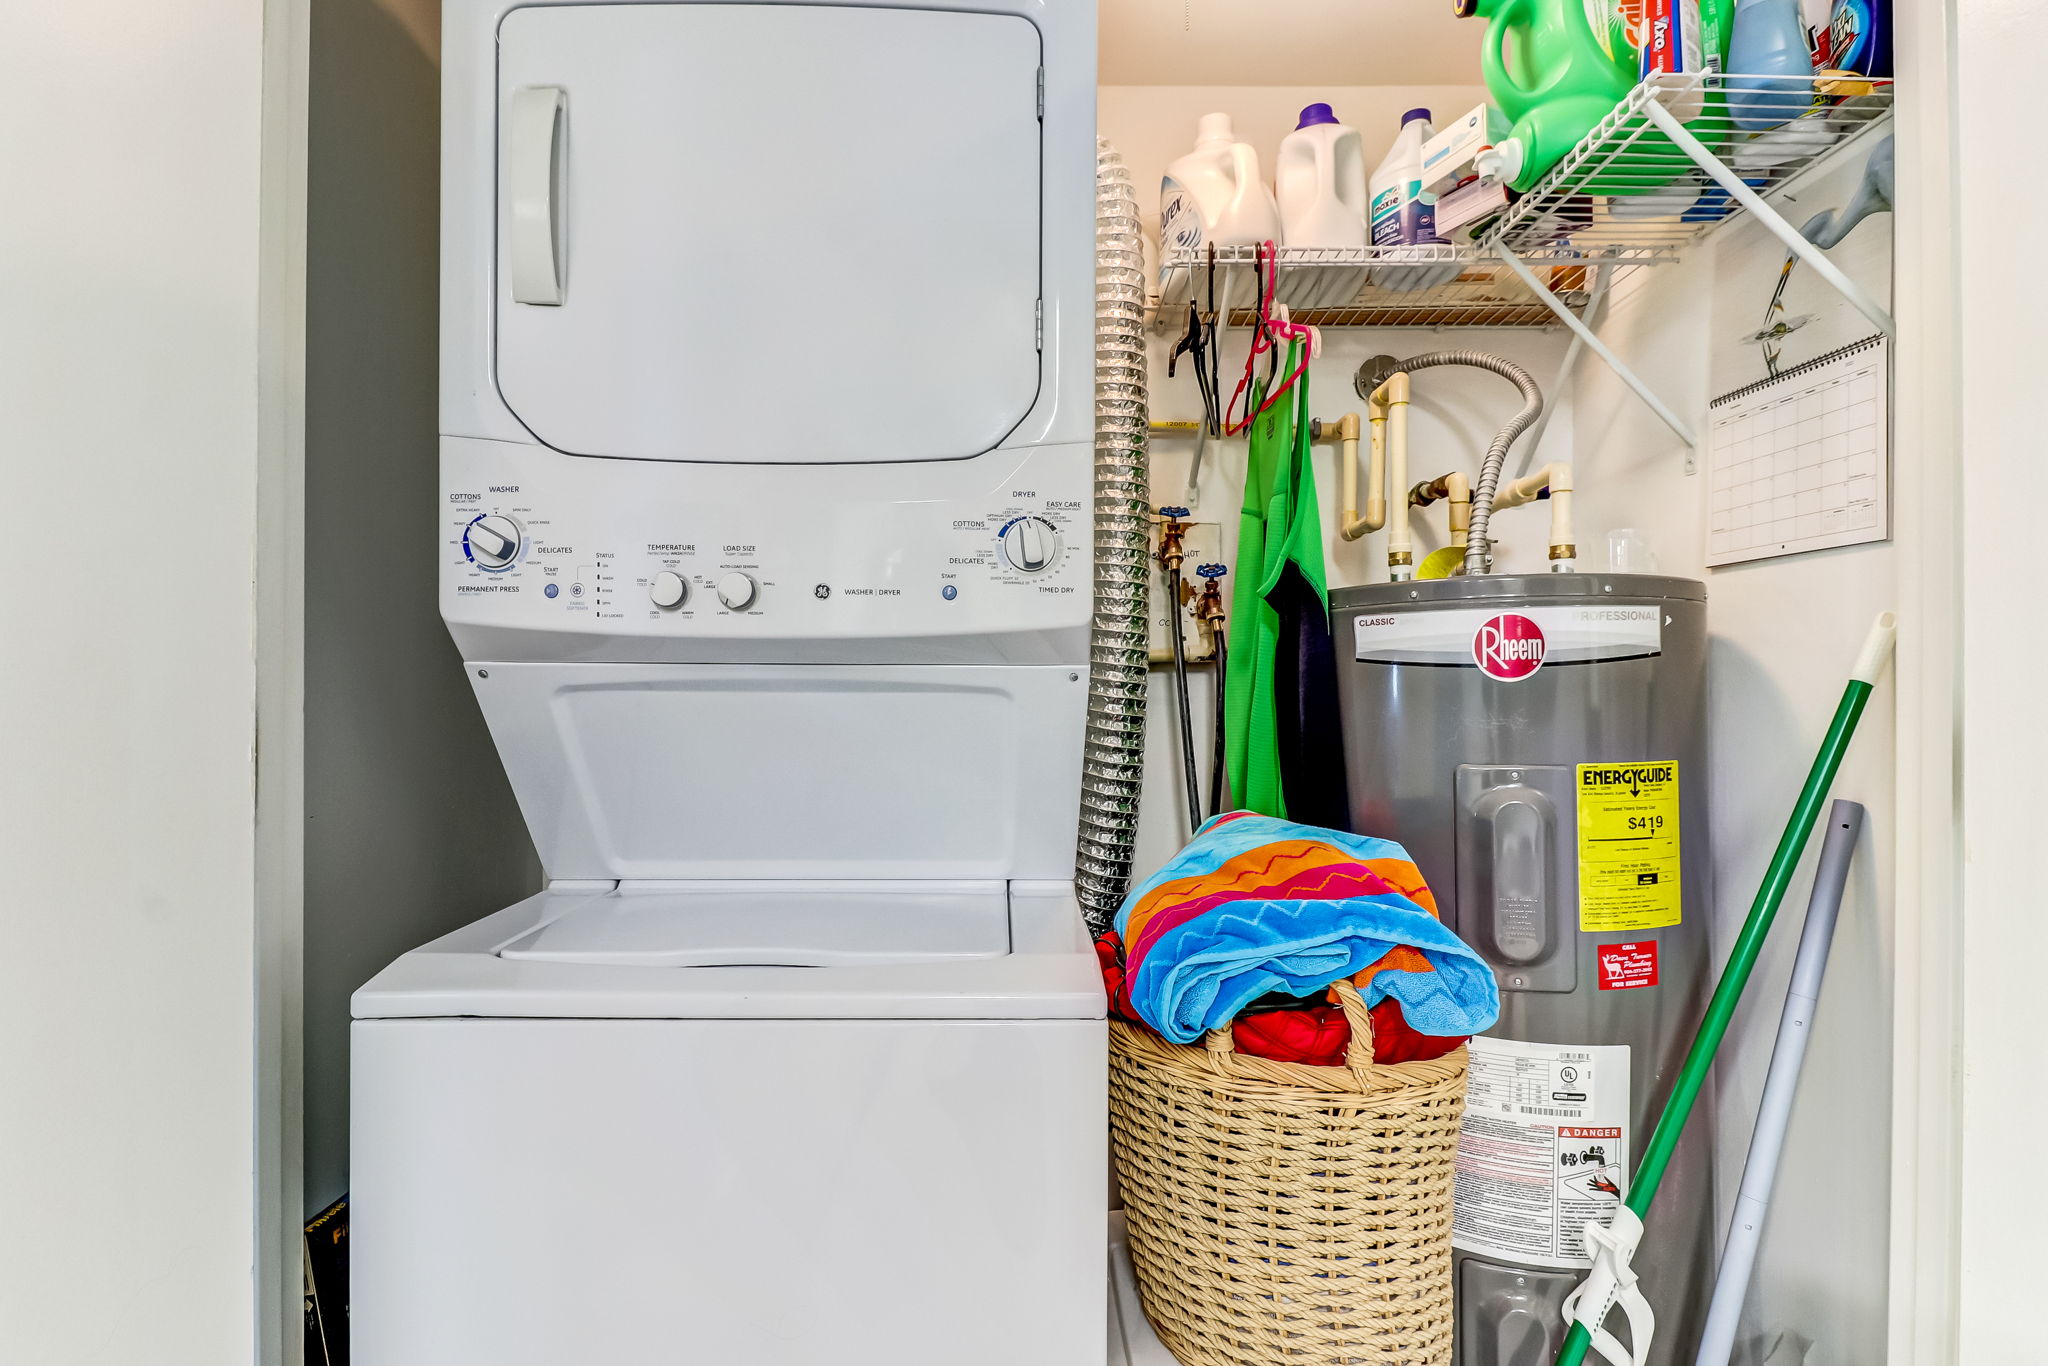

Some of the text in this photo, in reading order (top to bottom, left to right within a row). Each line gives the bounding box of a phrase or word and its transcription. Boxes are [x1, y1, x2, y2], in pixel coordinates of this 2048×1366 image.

[1184, 550, 1200, 558] HOT
[1359, 617, 1395, 627] CLASSIC
[1481, 615, 1543, 670] Rheem
[1583, 767, 1672, 786] ENERGYGUIDE
[1628, 815, 1663, 830] $419
[1574, 1128, 1618, 1137] DANGER
